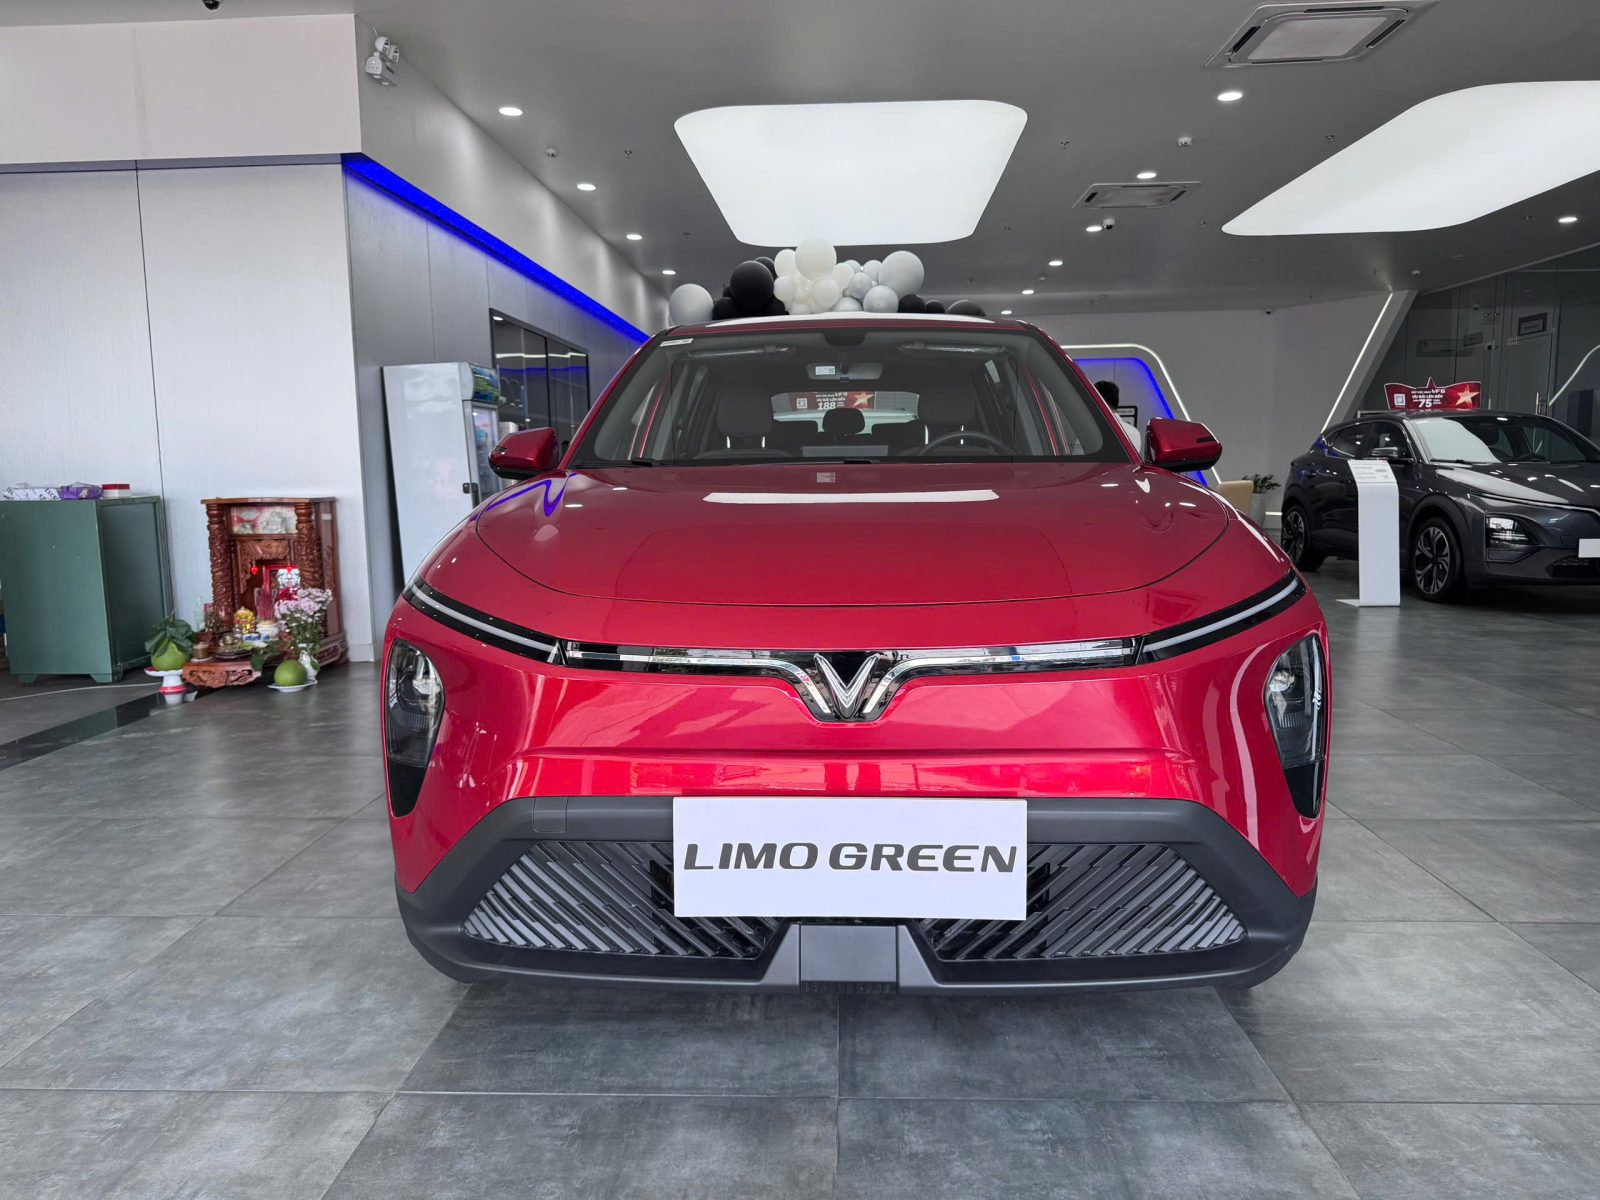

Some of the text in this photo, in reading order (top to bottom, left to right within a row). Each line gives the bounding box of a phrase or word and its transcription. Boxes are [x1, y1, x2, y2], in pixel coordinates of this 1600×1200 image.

[817, 401, 836, 410] 188
[1418, 399, 1432, 408] 75
[684, 843, 1017, 872] LIMO GREEN
